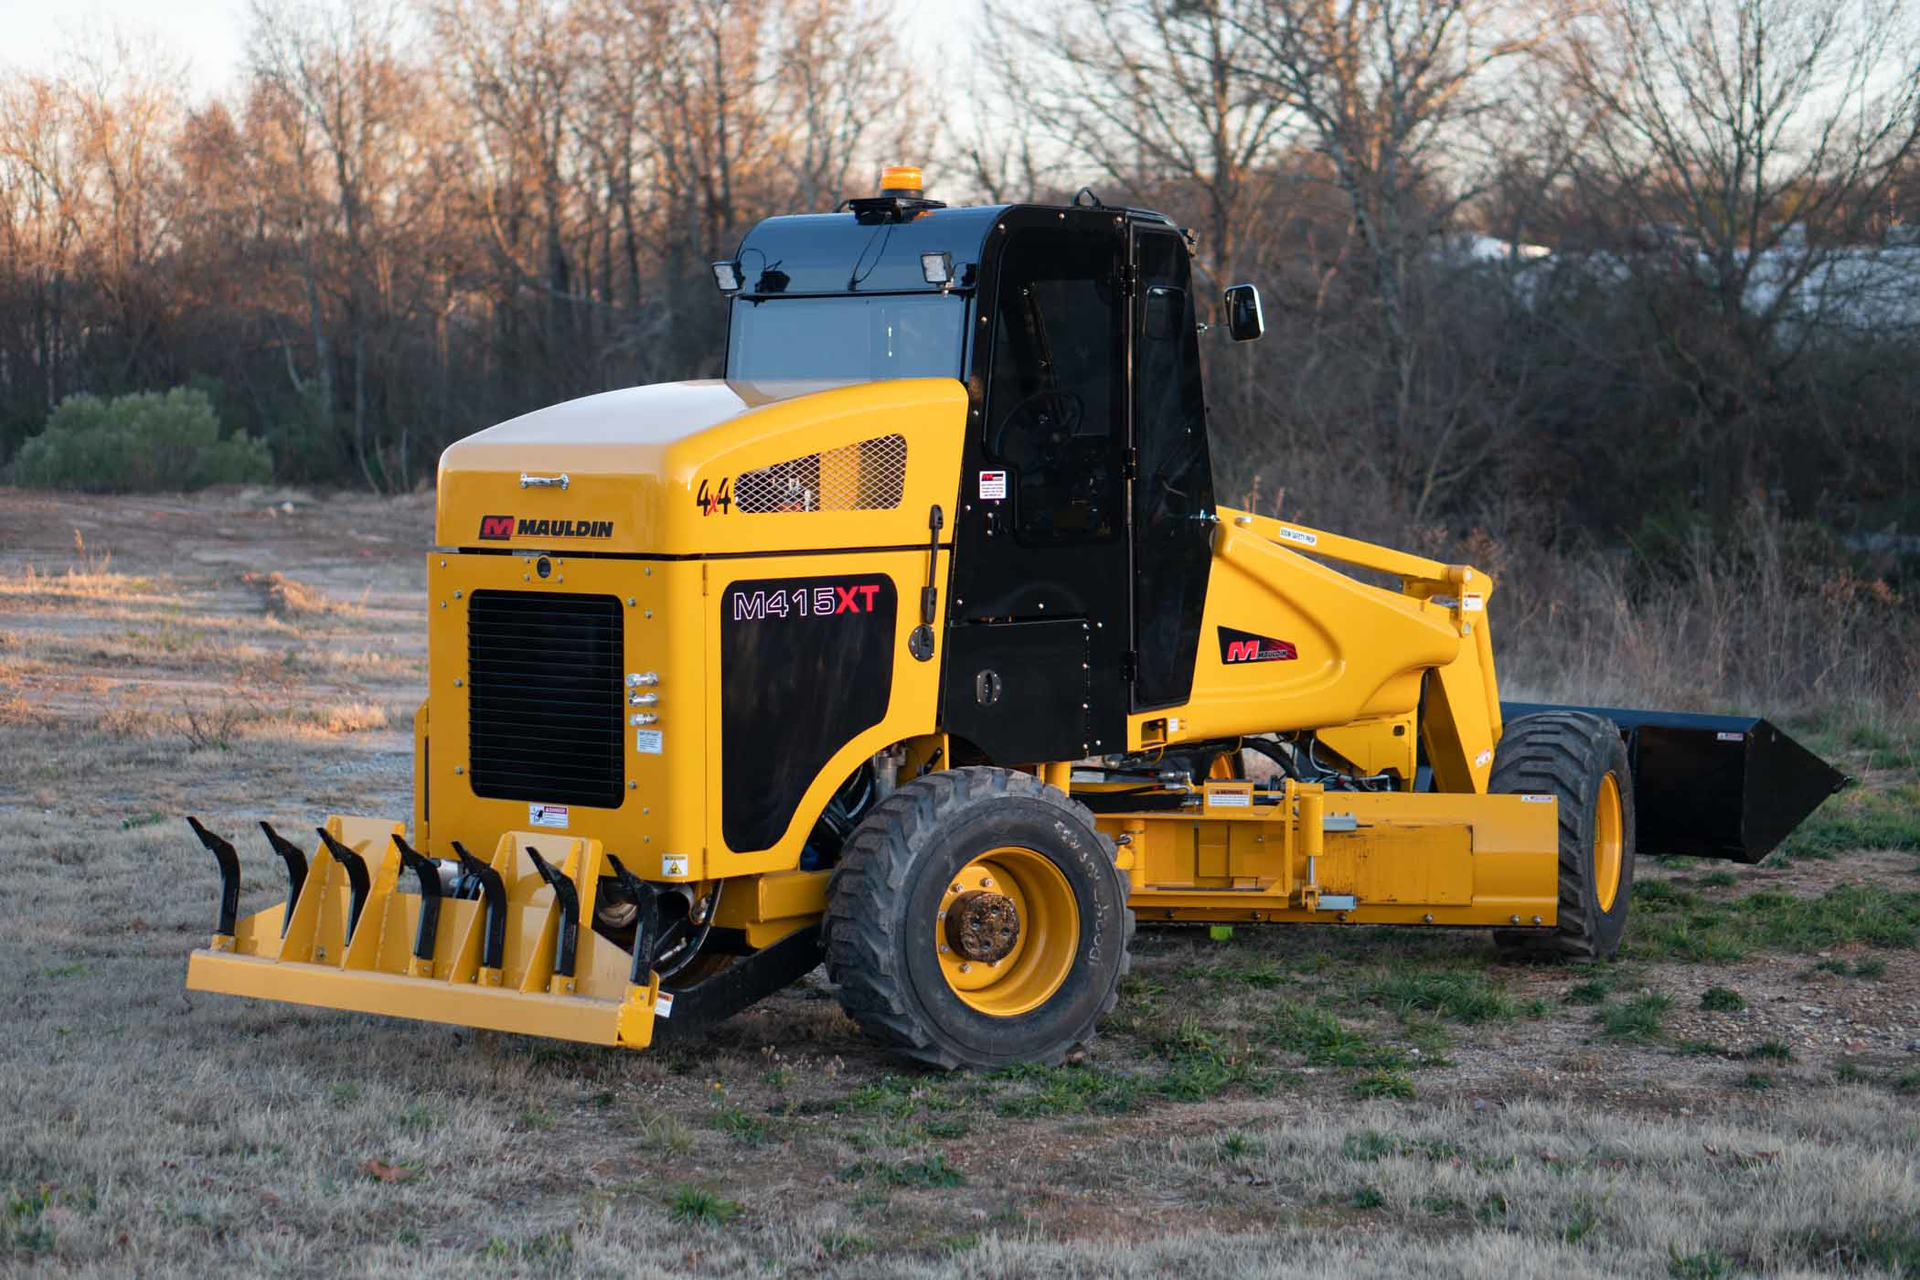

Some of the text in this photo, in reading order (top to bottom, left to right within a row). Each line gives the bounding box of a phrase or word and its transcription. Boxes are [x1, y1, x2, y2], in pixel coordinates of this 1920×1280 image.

[697, 478, 731, 516] 4x4
[481, 516, 613, 539] M MAULDIN
[734, 585, 880, 620] M415XT
[1227, 640, 1260, 661] M
